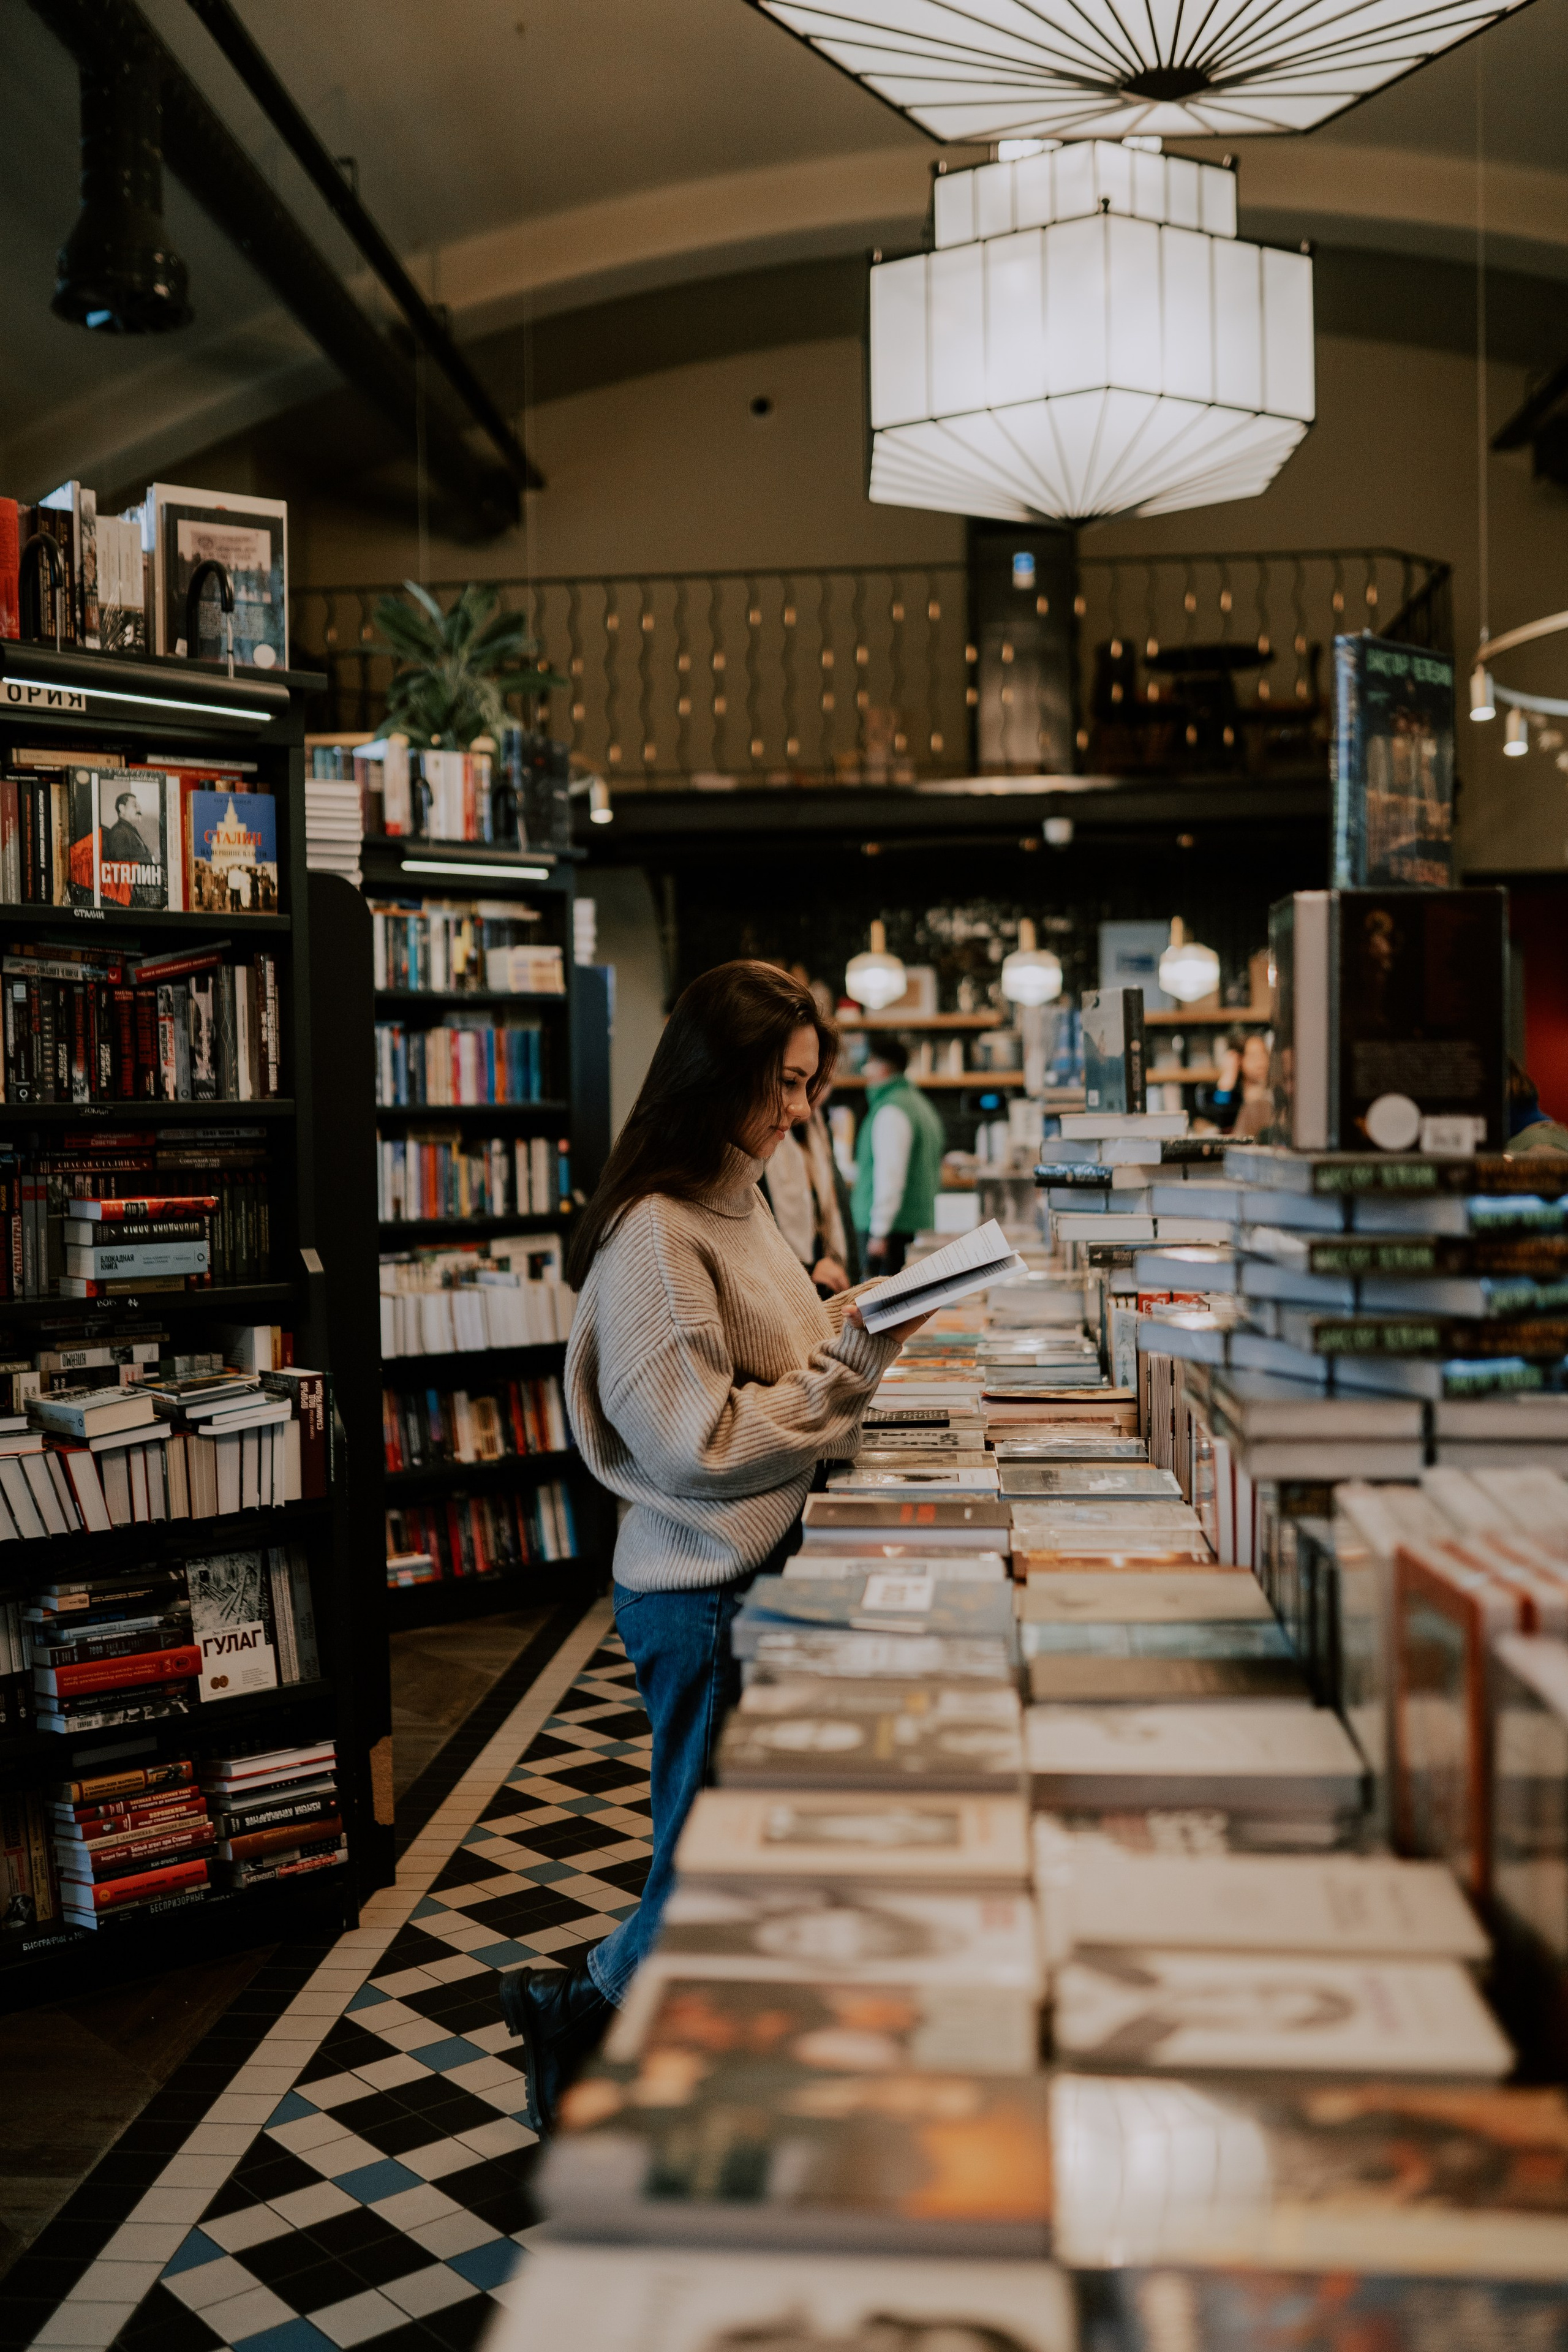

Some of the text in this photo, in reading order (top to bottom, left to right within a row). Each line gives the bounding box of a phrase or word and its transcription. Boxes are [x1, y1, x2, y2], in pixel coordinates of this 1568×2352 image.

[204, 829, 262, 846] СТАЛИН
[101, 862, 161, 886] СТАЛИН
[74, 908, 105, 920] СТАЛИН
[13, 1217, 22, 1273] СТАЛИНГРАД
[100, 1254, 135, 1264] БЛОКАДНАЯ
[100, 1262, 119, 1271] КНИГА
[62, 1352, 86, 1368] КЛЕЙМО
[300, 1381, 309, 1409] ПРОРЫВ
[315, 1379, 324, 1430] СТАЛИНГРАДОМ
[202, 1629, 262, 1657] ГУЛАГ
[85, 1776, 143, 1792] СТАЛИНСКИЕ МАРШАЛЫ
[129, 1796, 152, 1806] ВОЕННАЯ
[152, 1791, 178, 1802] АКАДЕМИЯ
[164, 1794, 191, 1804] ВОРОШИЛОВА
[149, 1806, 187, 1819] ВОРОШИЛОВ
[153, 1814, 176, 1823] СТАЛИНЫМ
[245, 1801, 322, 1826] ИЗМЕНА КОМАНДАРМОВ
[130, 1833, 193, 1853] Белый агент при Сталине
[100, 1853, 116, 1862] Андрей
[246, 1869, 277, 1884] СОЛОНЕВИЧ
[149, 1891, 205, 1914] БЕСПРИЗОРНЫЕ
[23, 1933, 67, 1951] БИОГРАФИИ
